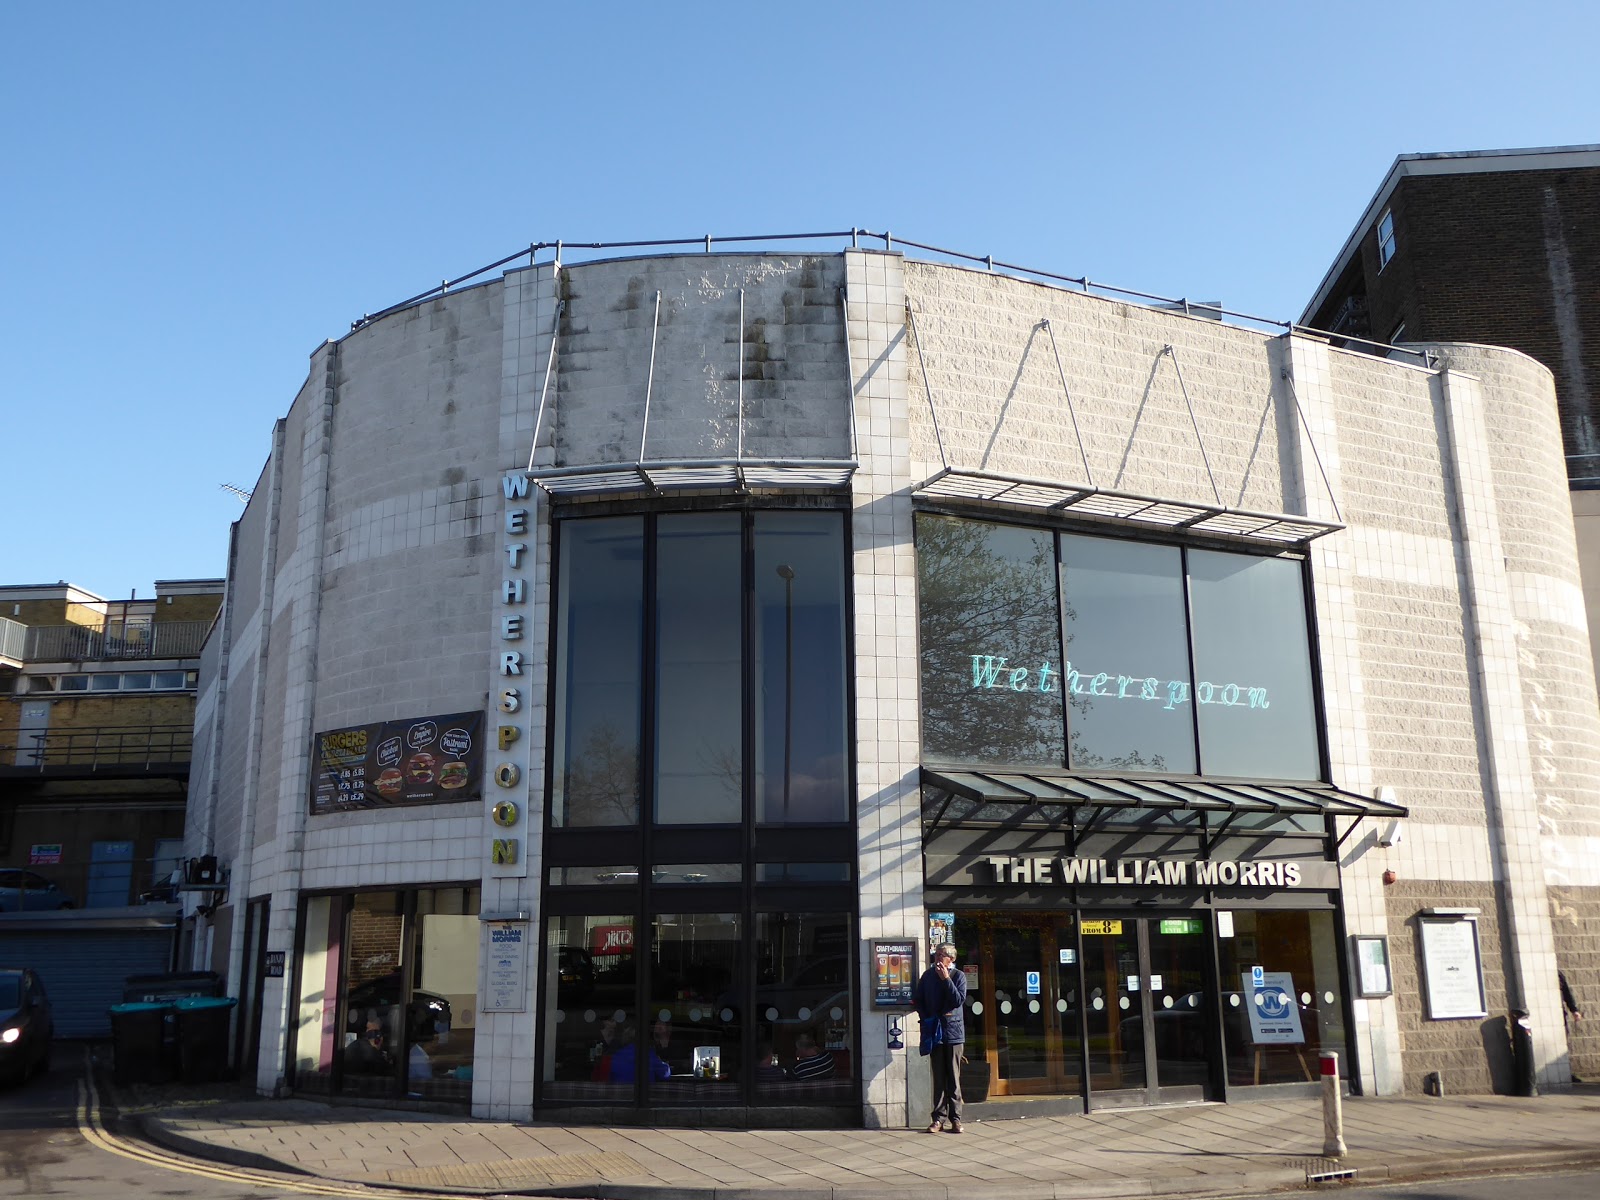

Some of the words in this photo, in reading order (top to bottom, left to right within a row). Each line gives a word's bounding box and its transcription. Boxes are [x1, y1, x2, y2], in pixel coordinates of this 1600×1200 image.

[492, 475, 529, 865] WETHERSPOON
[971, 654, 1270, 710] Wetherspoon
[321, 730, 367, 751] BURGERS
[988, 857, 1053, 884] THE
[1061, 858, 1188, 885] WILLIAM
[1196, 860, 1302, 886] MORRIS
